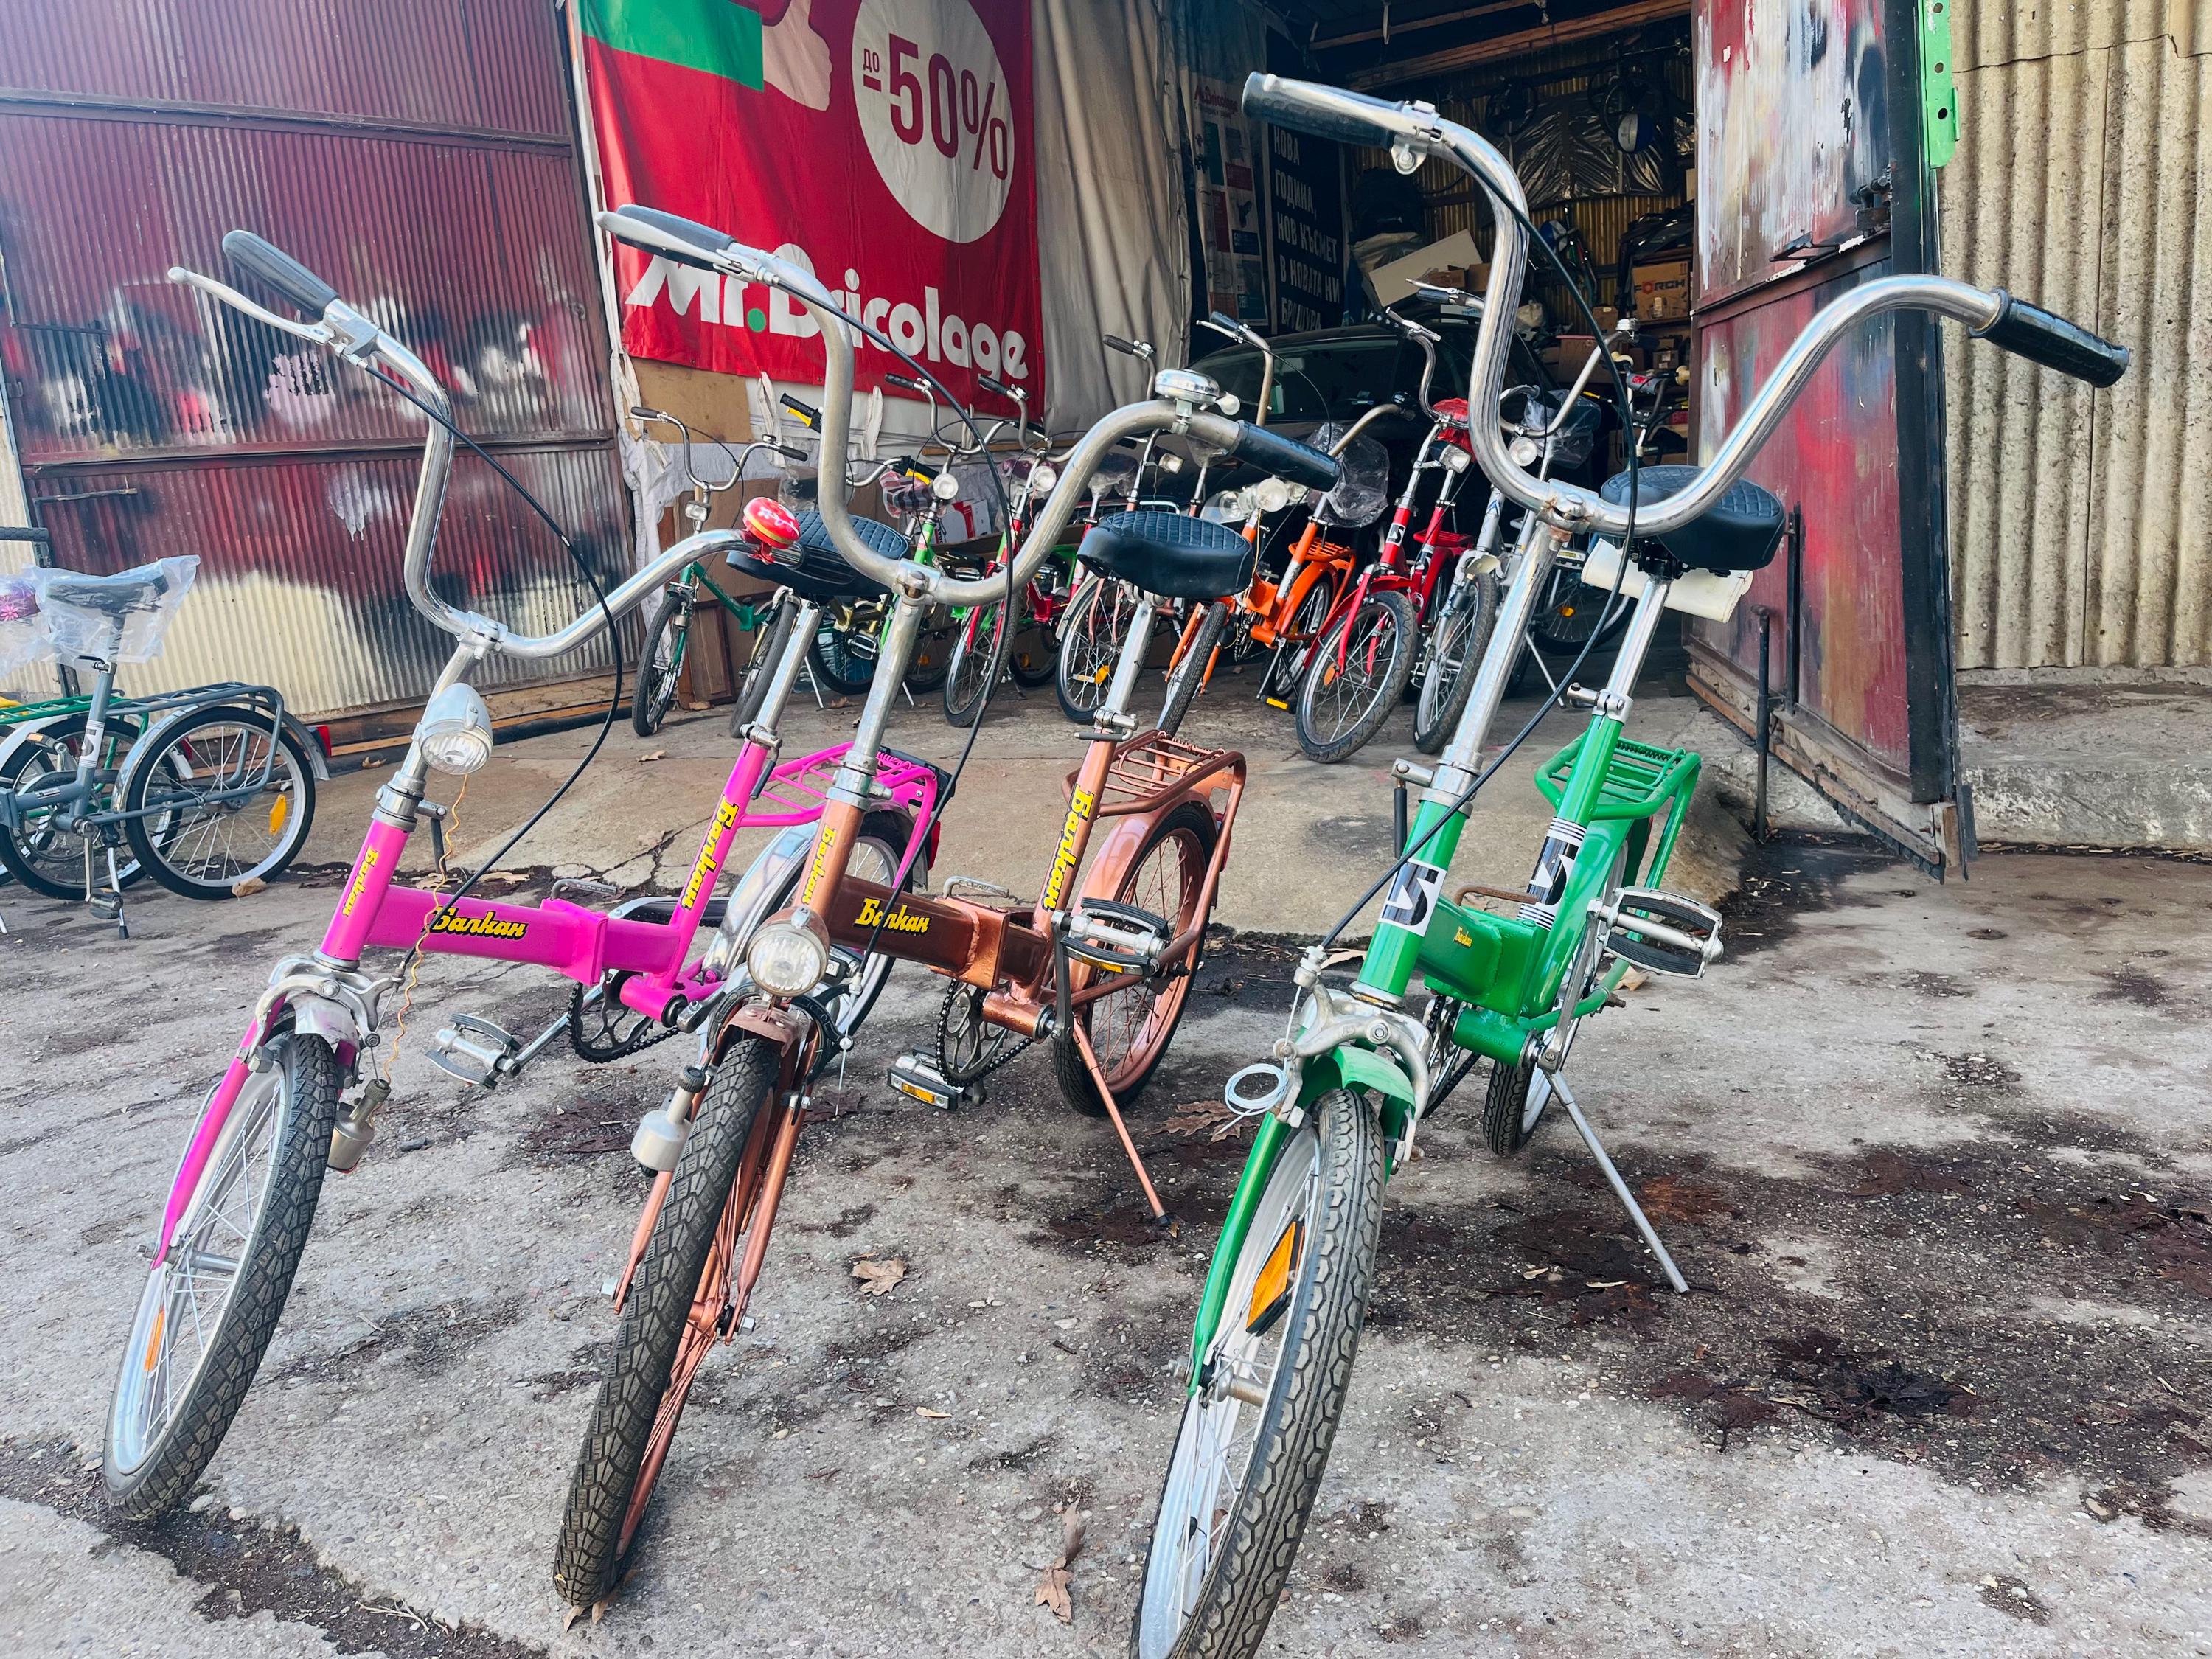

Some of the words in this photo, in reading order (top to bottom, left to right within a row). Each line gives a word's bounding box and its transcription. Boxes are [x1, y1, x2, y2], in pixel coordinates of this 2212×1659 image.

[1273, 125, 1300, 166] НОВА
[1275, 168, 1317, 220] ГОДИНА,
[1277, 212, 1298, 246] НОВ
[1299, 222, 1338, 265] КЪСМЕТ
[1279, 254, 1287, 283] В
[1290, 259, 1322, 299] НОВАТА
[1325, 274, 1340, 304] НИ
[625, 243, 1029, 380] Mr.Bicolage
[680, 795, 739, 909] Балкан
[1042, 783, 1094, 912] Балкан
